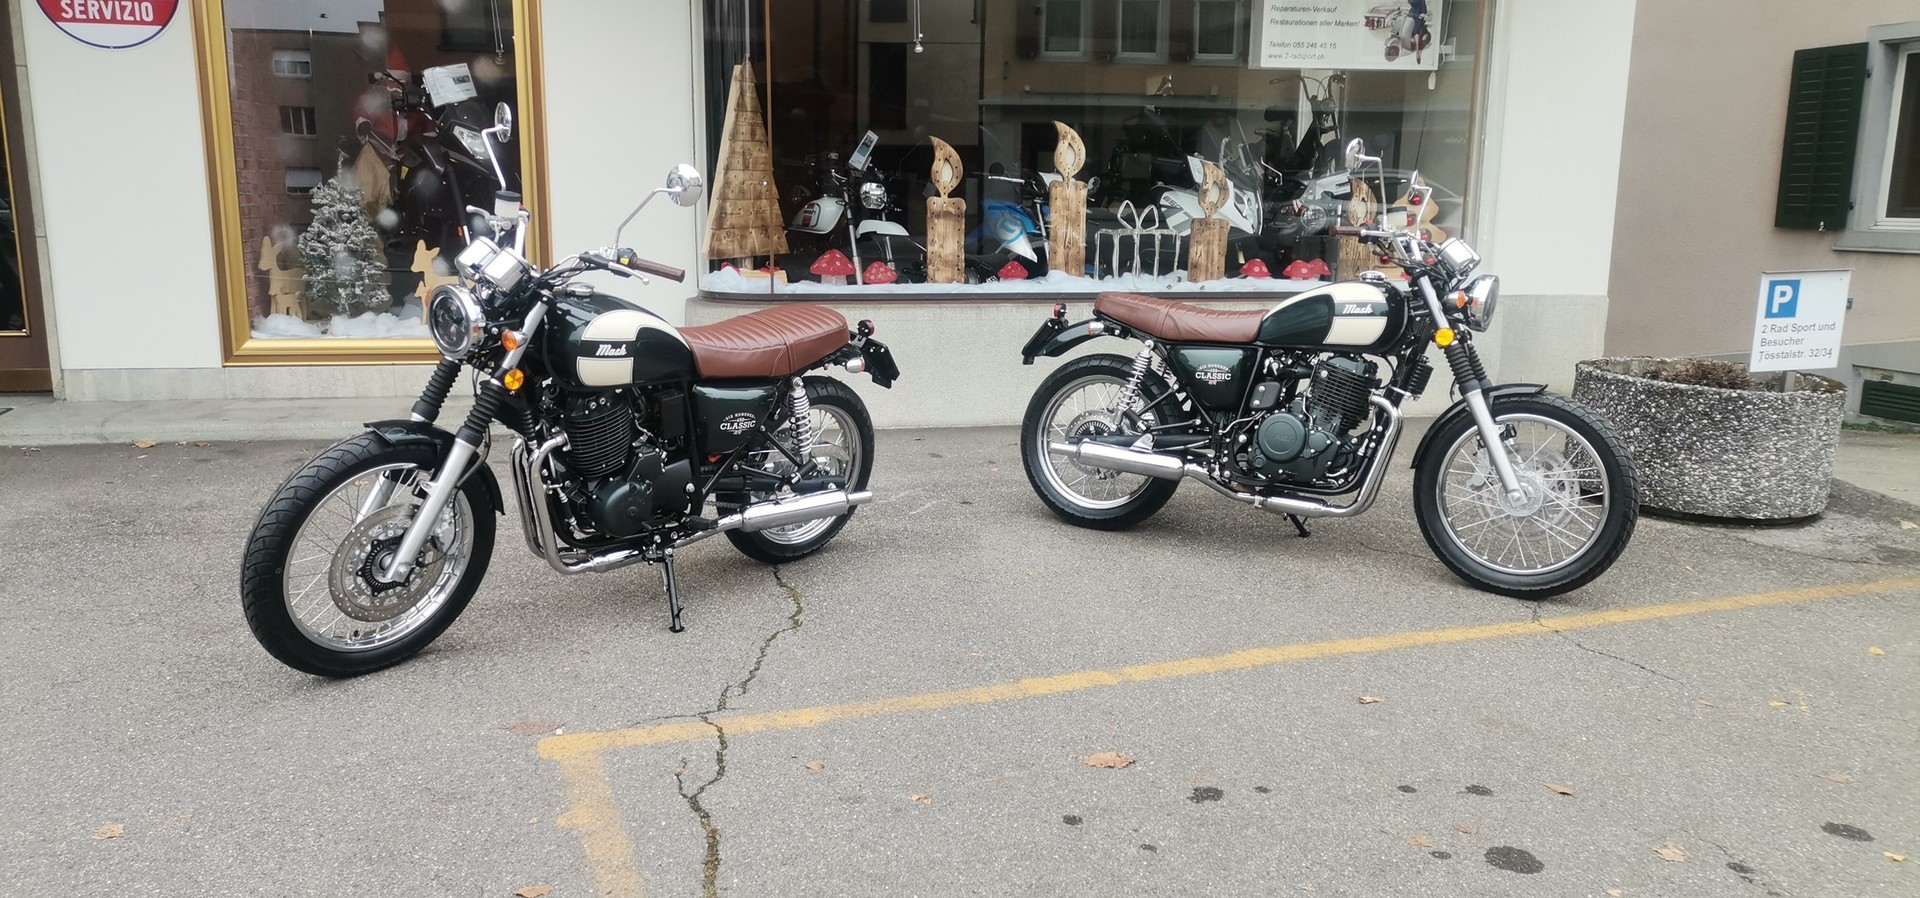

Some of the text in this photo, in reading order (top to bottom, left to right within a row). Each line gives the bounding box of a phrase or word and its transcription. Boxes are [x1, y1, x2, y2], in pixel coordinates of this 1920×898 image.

[61, 0, 154, 21] SERVIZIO
[1271, 5, 1337, 13] Reparaturen-Verkauf
[1270, 18, 1318, 26] Restaurationen
[1771, 285, 1793, 314] P
[1342, 303, 1374, 314] Mash
[1761, 322, 1836, 334] 2 Rad Sport und
[1760, 337, 1805, 347] Besucher
[595, 344, 627, 356] Mash
[1808, 348, 1833, 358] 32/34
[1195, 372, 1232, 380] CLASSIC
[720, 420, 756, 430] CLASSIC
